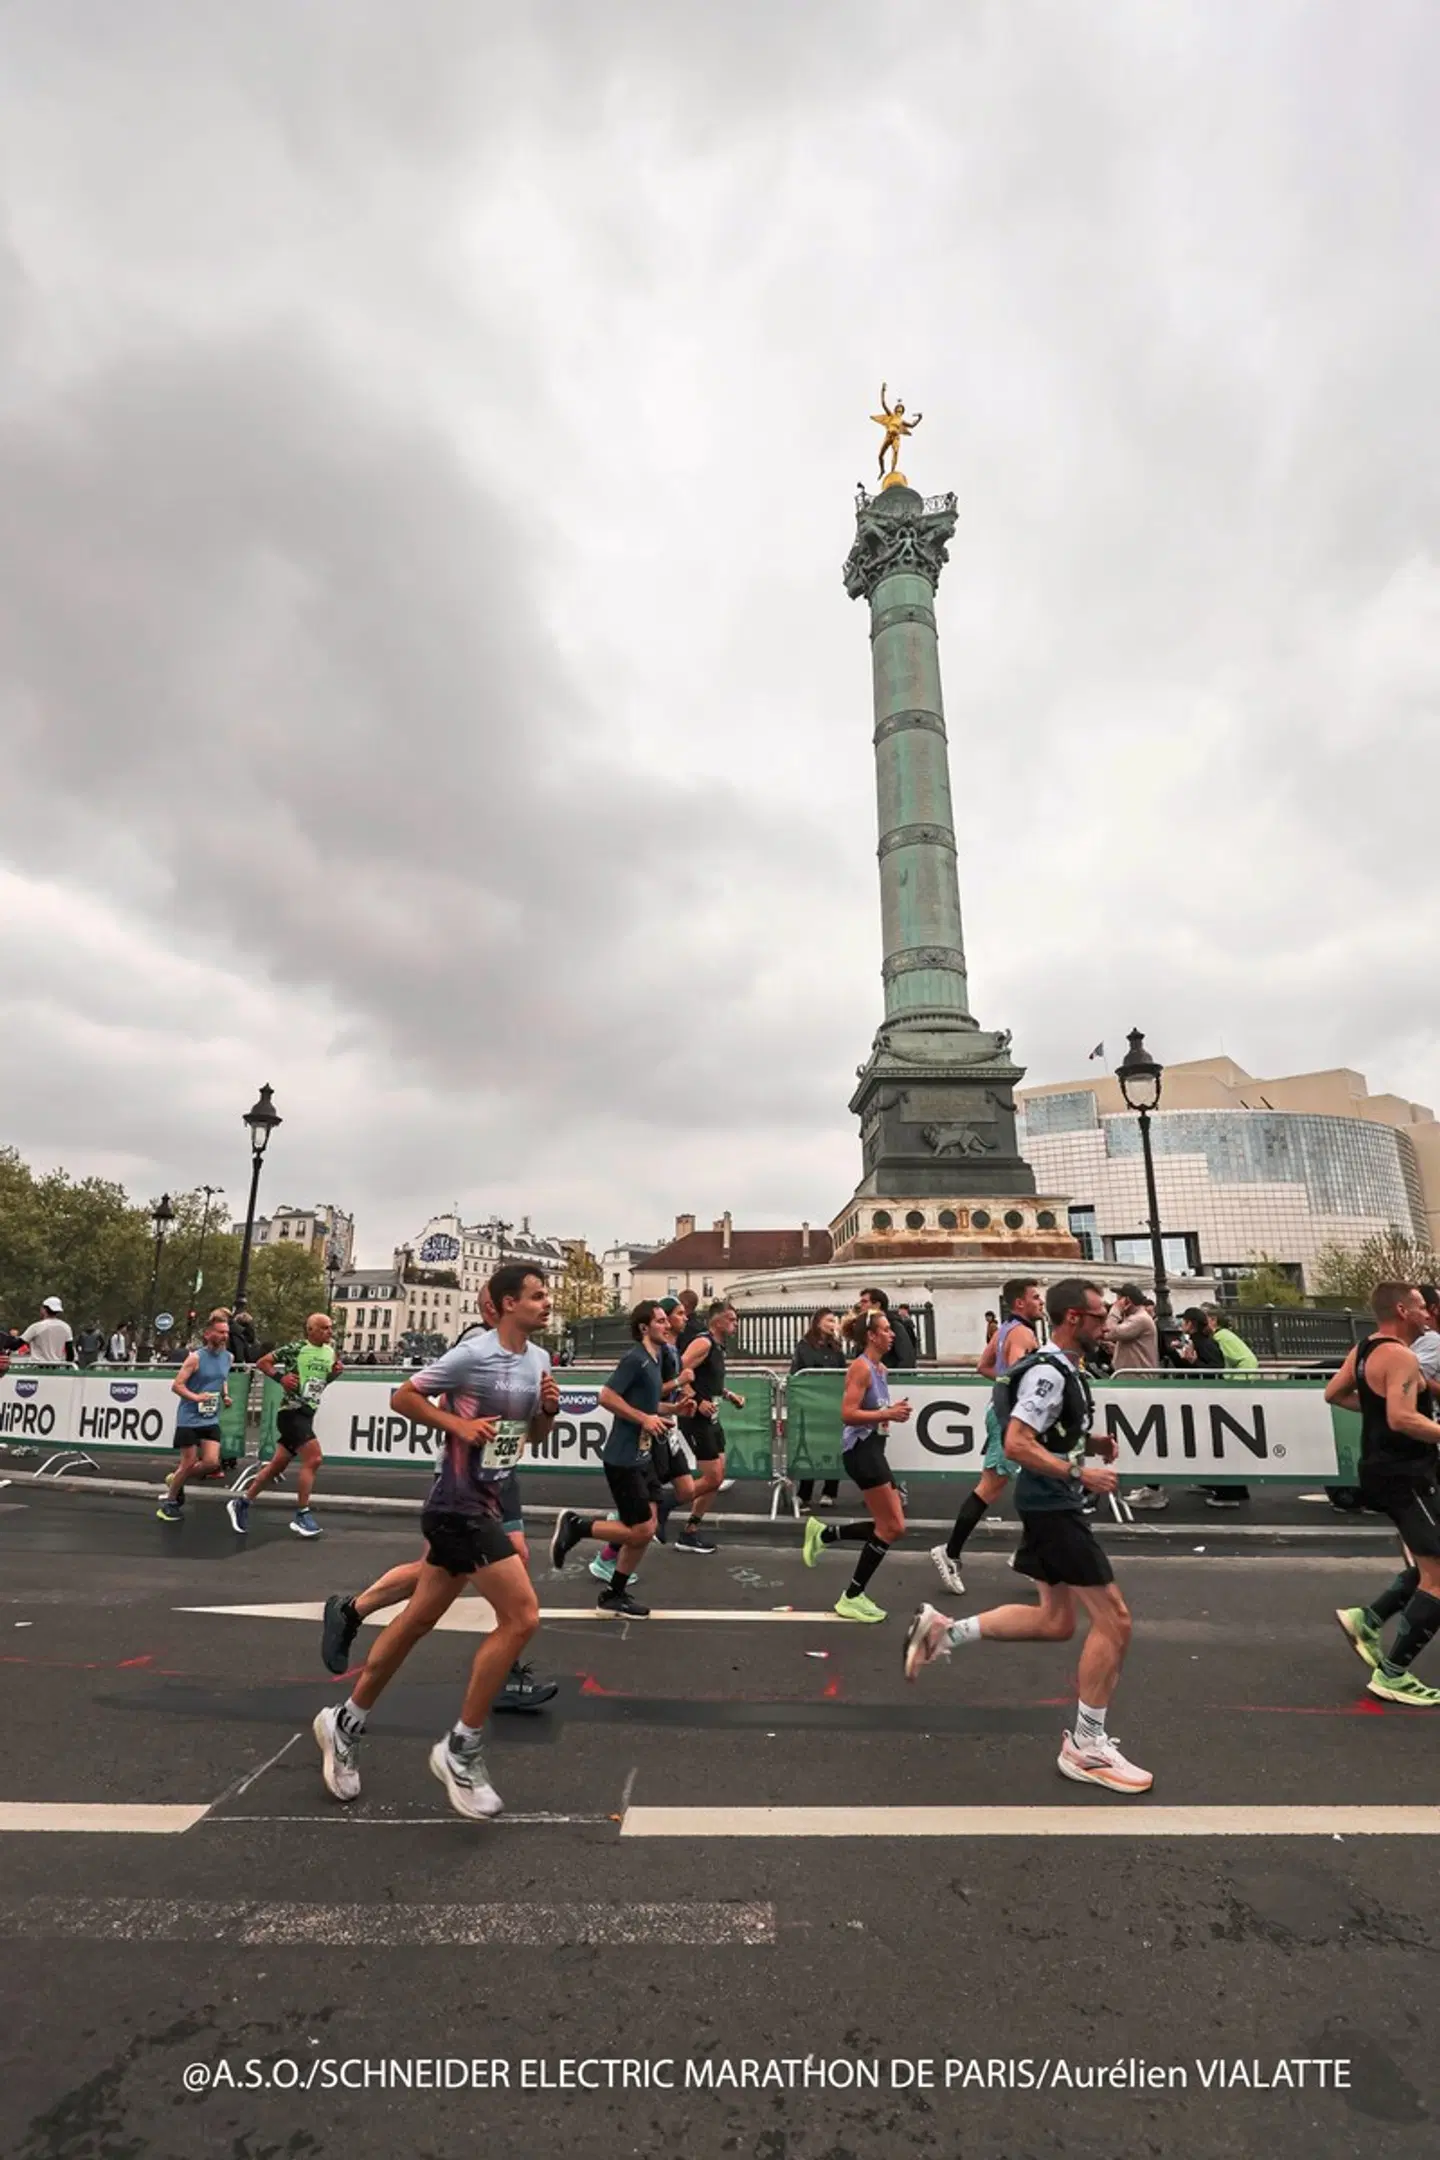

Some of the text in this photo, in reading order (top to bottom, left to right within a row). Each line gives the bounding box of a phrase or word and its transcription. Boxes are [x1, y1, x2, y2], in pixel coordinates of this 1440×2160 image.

[112, 1386, 136, 1395] DANONE
[79, 1406, 163, 1442] HiPRO
[916, 1400, 1268, 1459] GMIN
